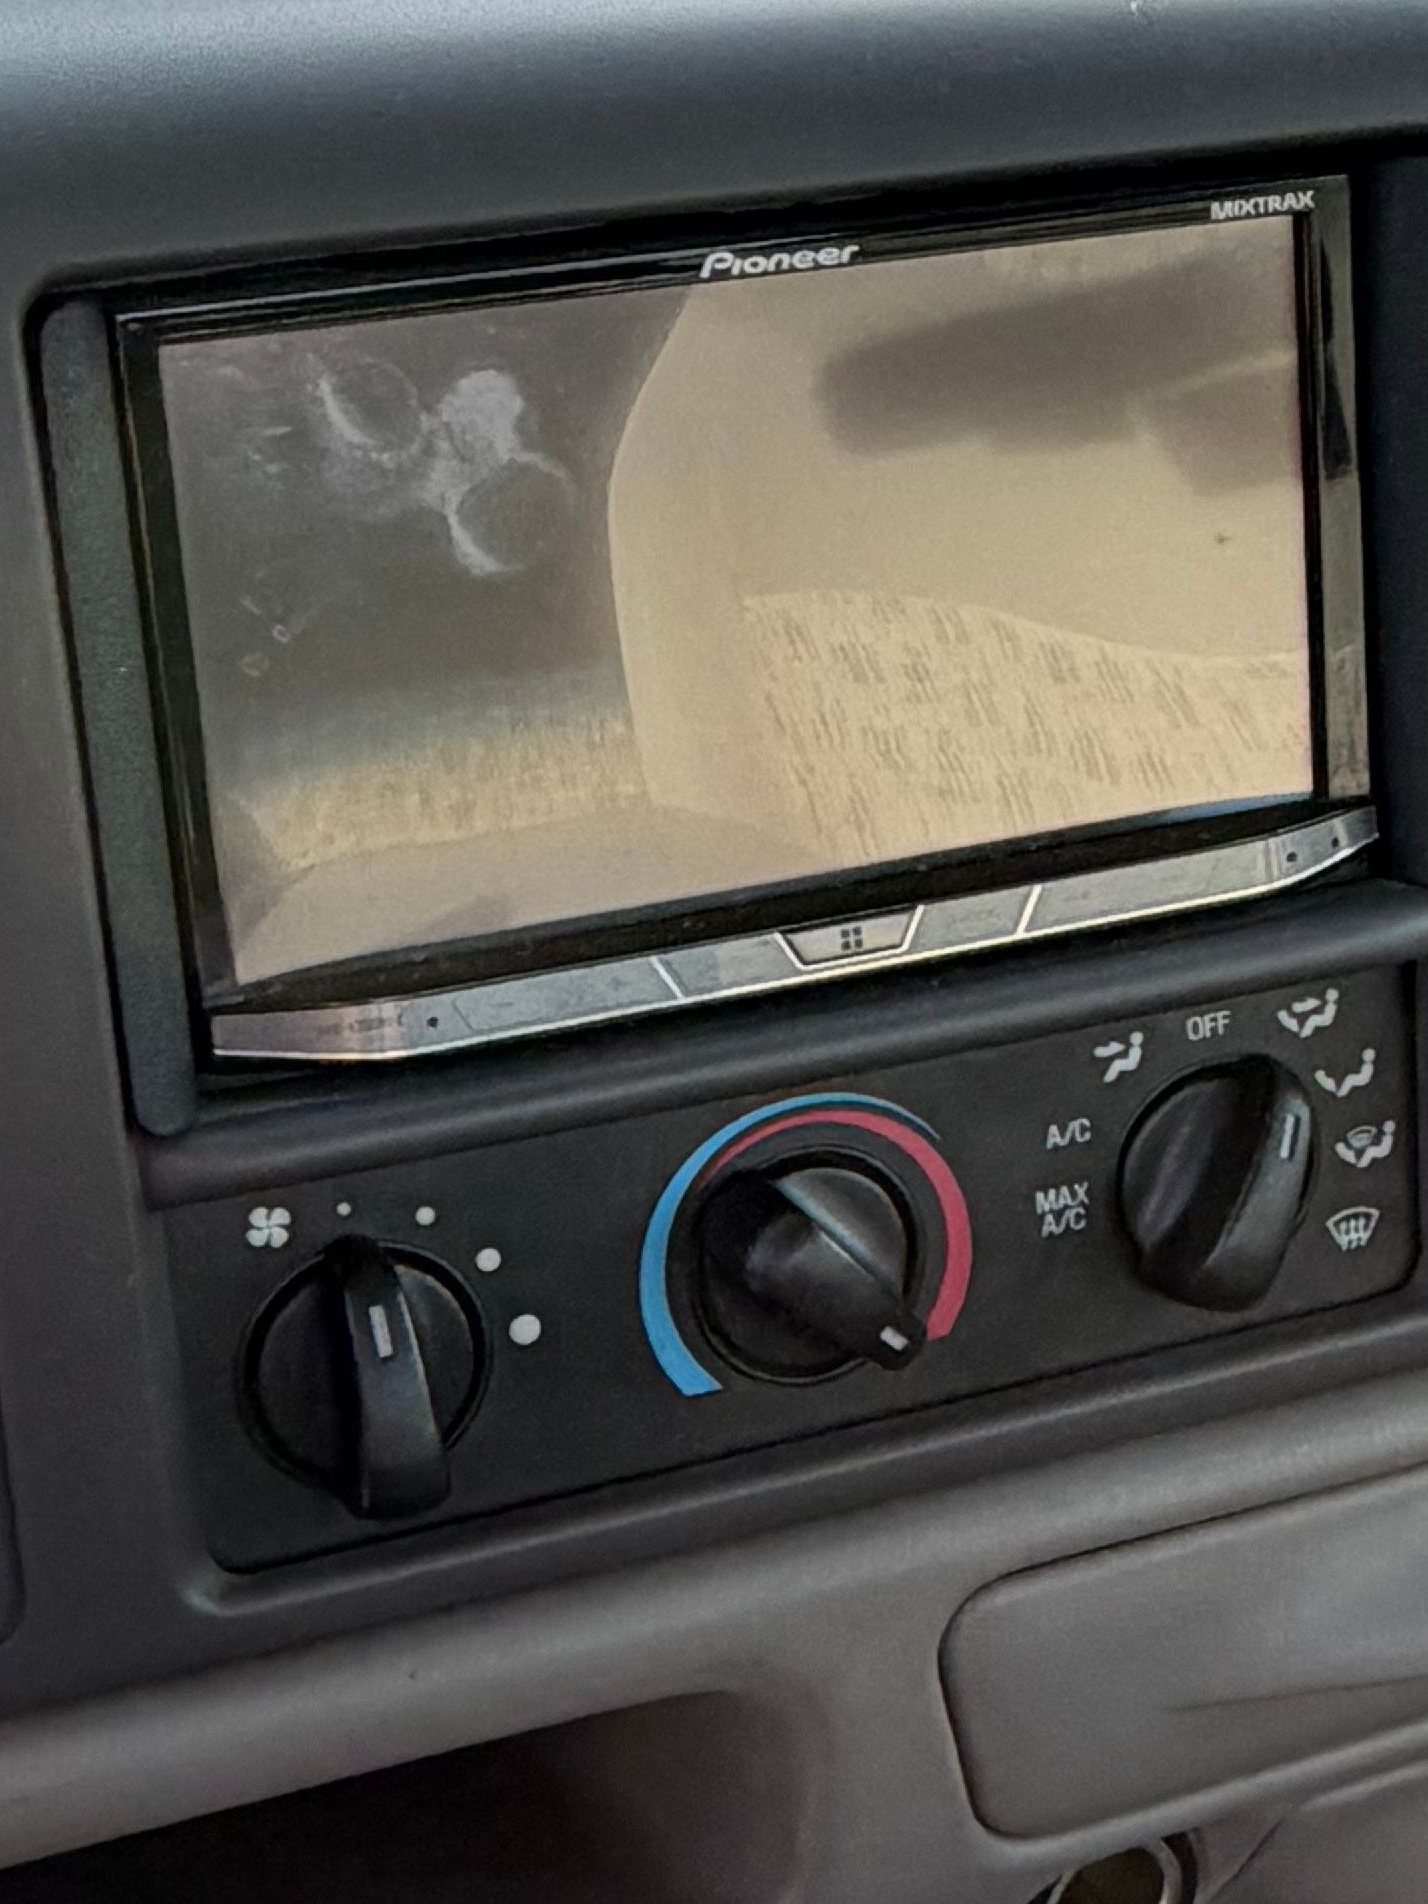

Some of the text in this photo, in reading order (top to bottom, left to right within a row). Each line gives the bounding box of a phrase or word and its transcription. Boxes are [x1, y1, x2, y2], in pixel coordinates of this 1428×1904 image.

[1210, 190, 1315, 220] MIXTRAX
[699, 244, 860, 279] Pioneer
[1185, 1010, 1231, 1041] OFF
[1046, 1118, 1092, 1150] A/C
[1035, 1181, 1090, 1215] MAX
[1041, 1206, 1086, 1238] A/C
